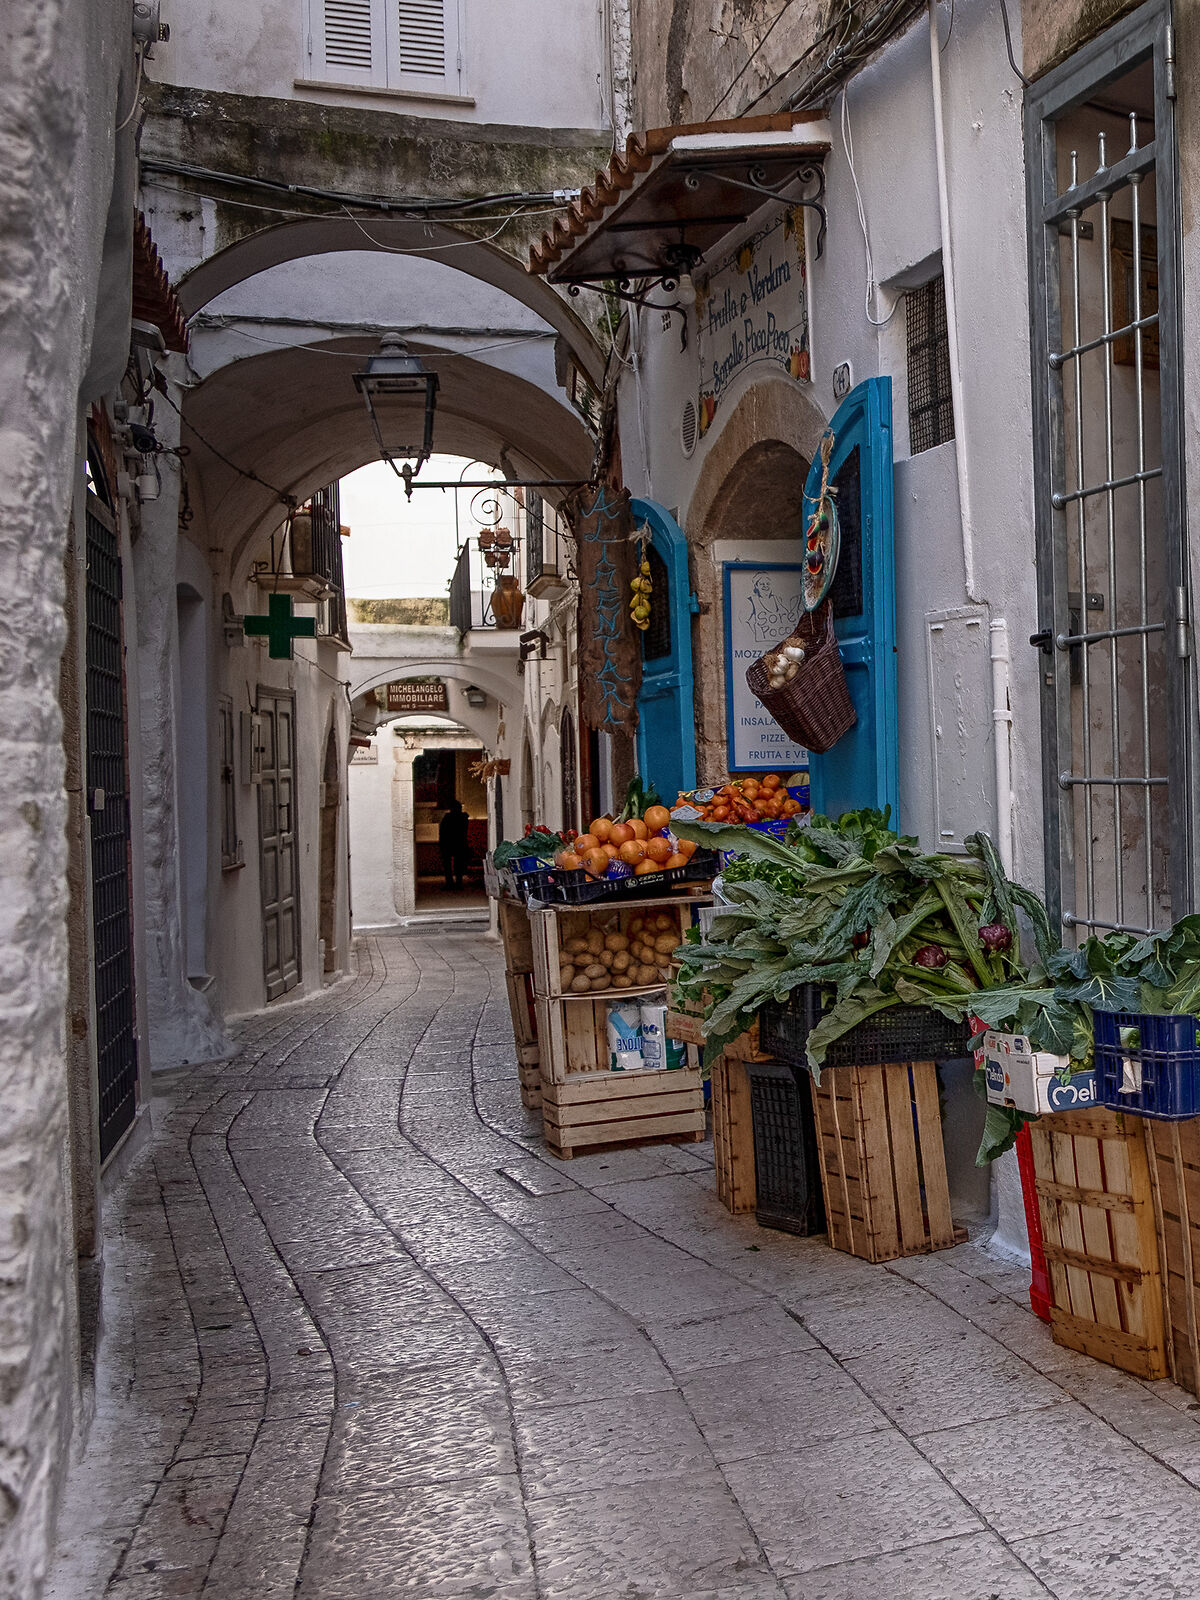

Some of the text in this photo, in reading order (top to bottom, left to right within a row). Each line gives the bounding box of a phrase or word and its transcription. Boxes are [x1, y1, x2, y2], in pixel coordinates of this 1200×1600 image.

[708, 256, 791, 336] Frutta e Verdura
[744, 318, 766, 363] Poco
[766, 311, 790, 355] Poco
[581, 487, 632, 725] ALIMENTARI
[390, 684, 443, 693] MICHELANGELO
[390, 694, 444, 702] IMMOBILIARE
[761, 734, 785, 743] PIZZE
[748, 750, 783, 759] FRUTTA
[785, 750, 791, 759] E
